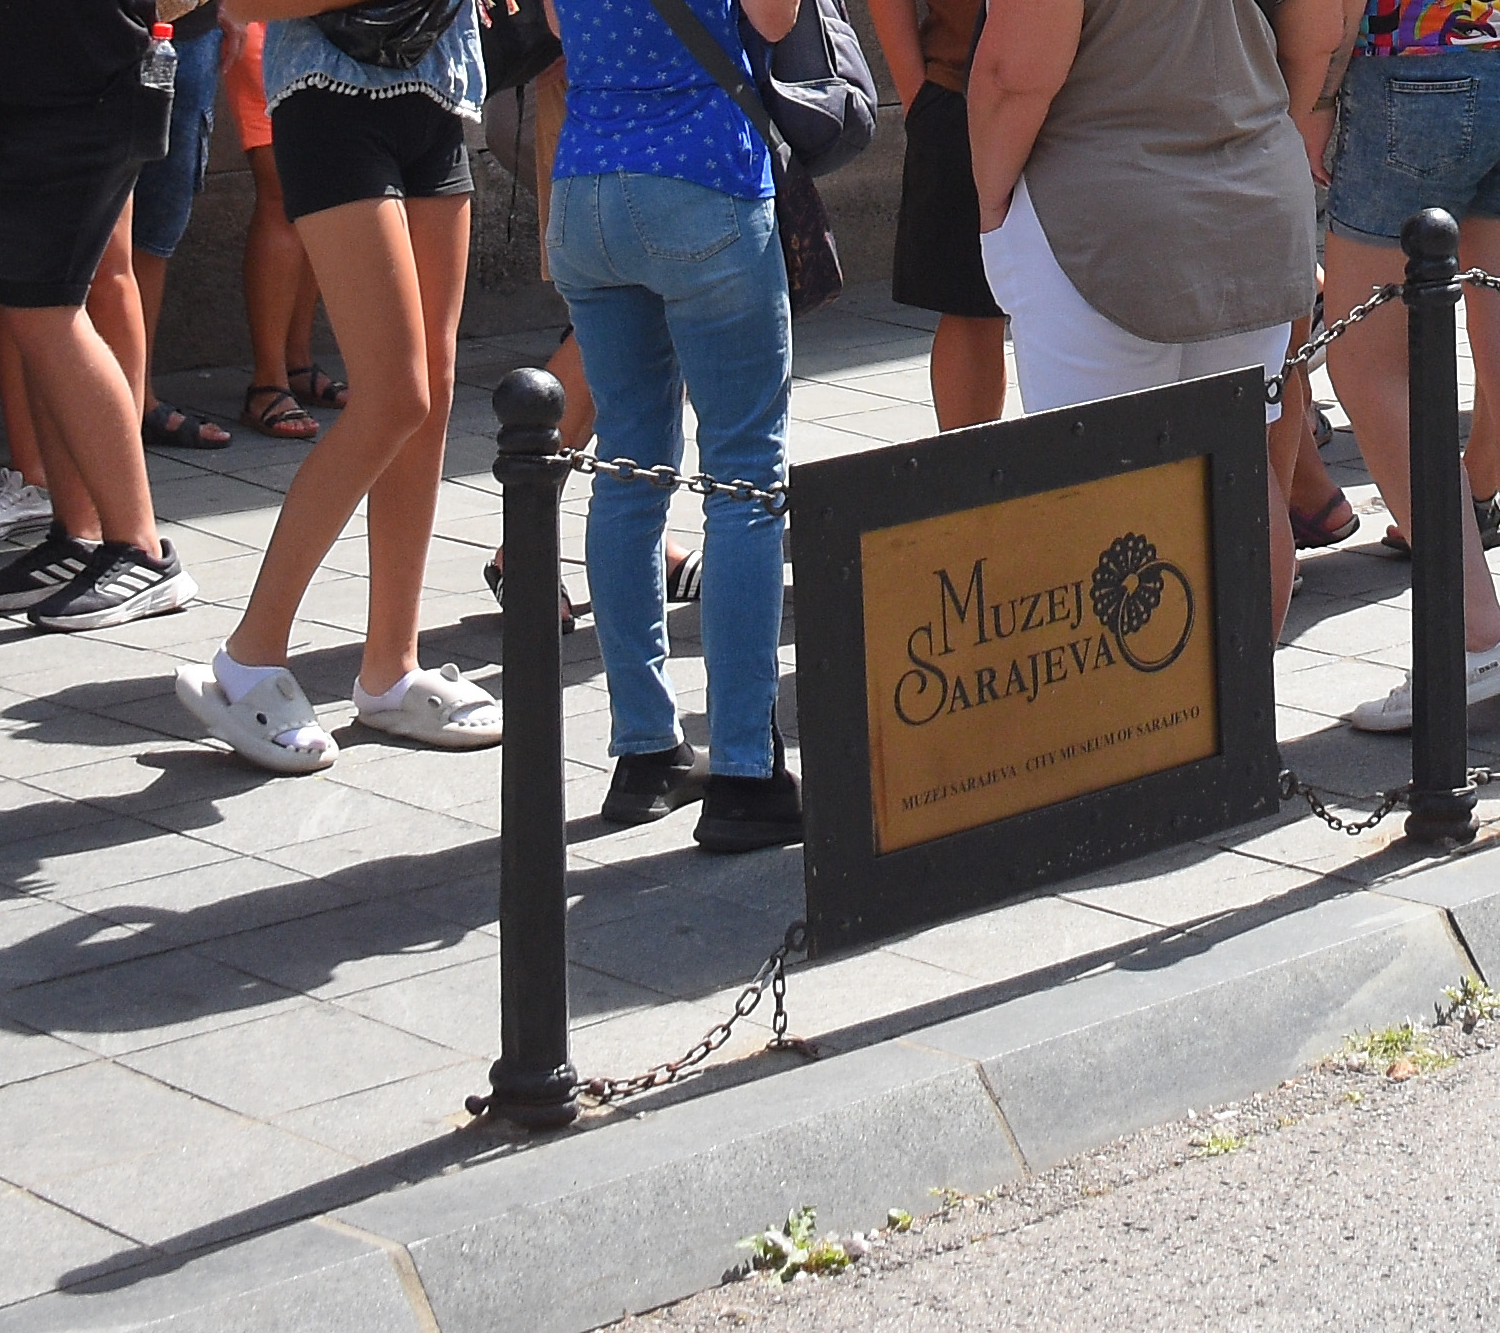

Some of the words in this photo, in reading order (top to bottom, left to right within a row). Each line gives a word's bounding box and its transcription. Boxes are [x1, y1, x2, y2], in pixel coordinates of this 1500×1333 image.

[933, 556, 1087, 658] MUZEJ
[893, 620, 1119, 728] SARAJEVA
[902, 788, 948, 812] MUZEJ
[949, 763, 1017, 796] SARAJEVA
[1024, 751, 1057, 773] CITY
[1059, 732, 1116, 762] MUSEUM
[1116, 726, 1135, 743] OF
[1135, 704, 1201, 737] SARAJEVO
